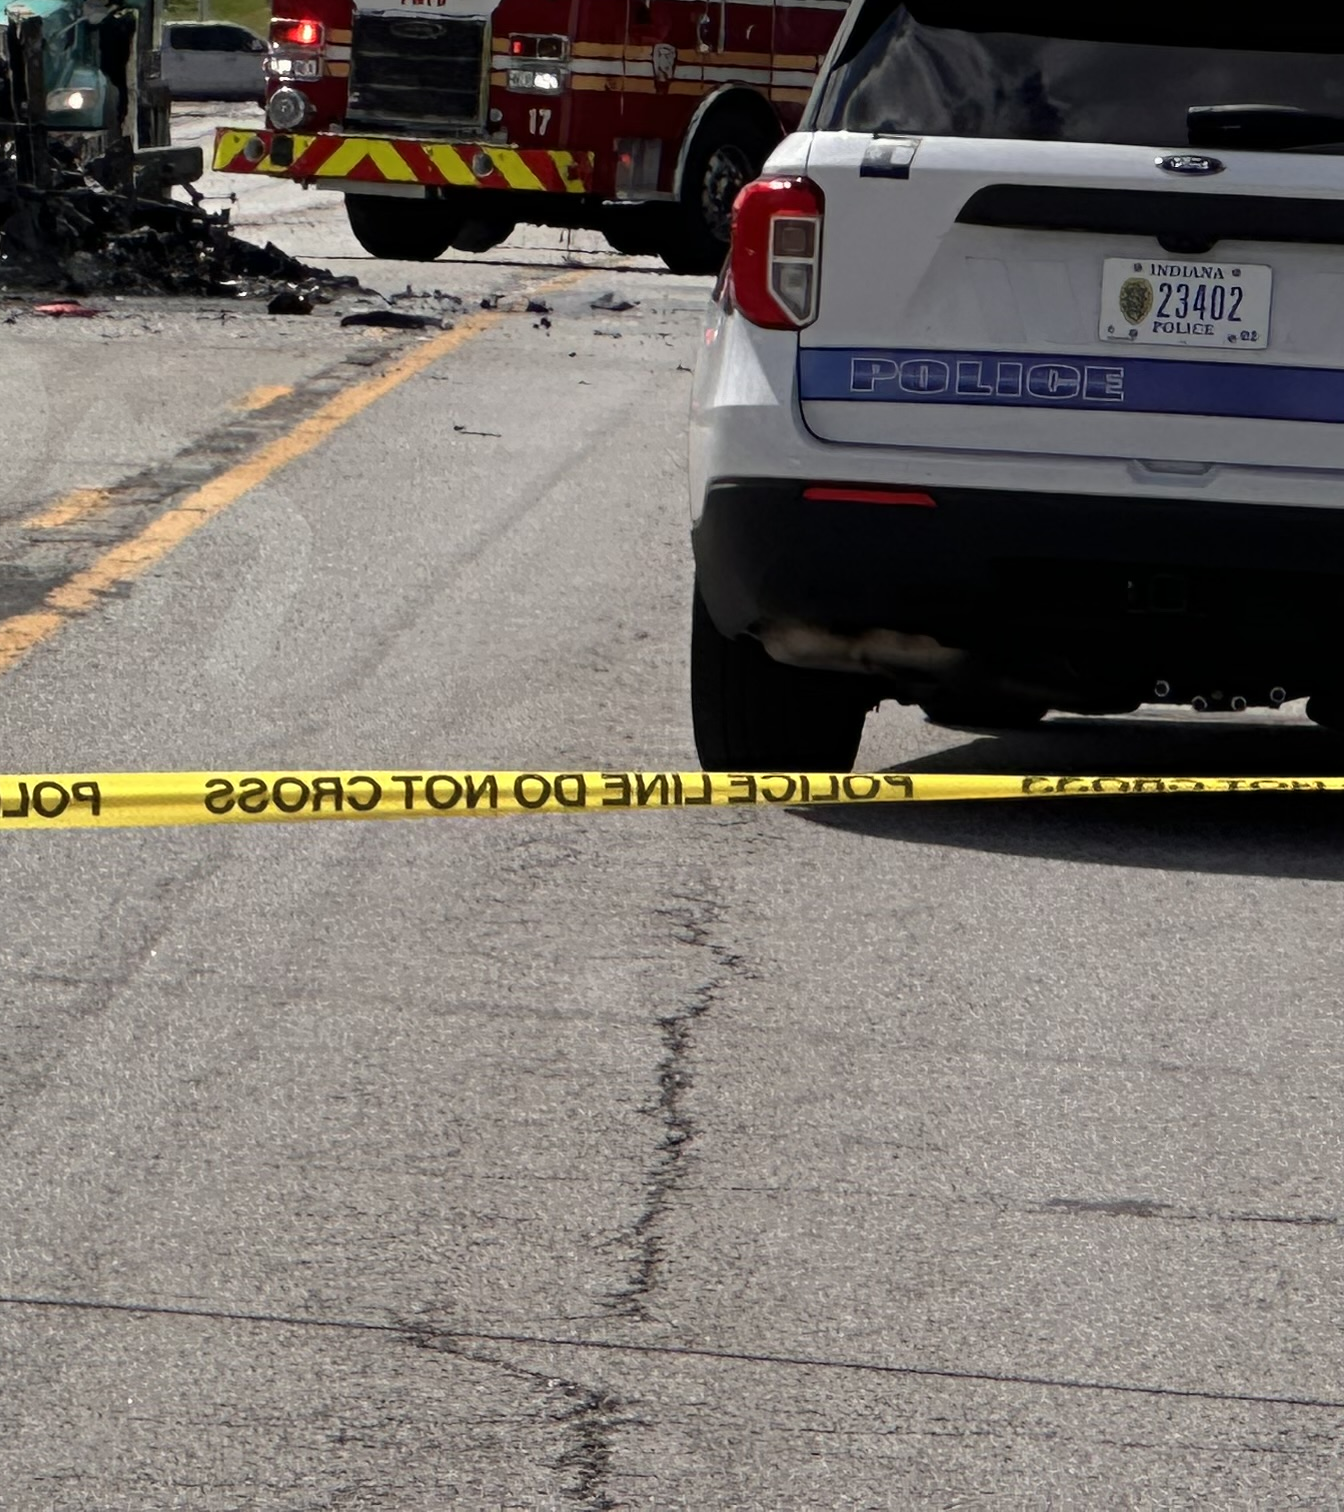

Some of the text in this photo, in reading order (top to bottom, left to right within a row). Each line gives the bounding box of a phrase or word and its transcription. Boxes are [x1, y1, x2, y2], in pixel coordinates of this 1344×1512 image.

[528, 107, 552, 136] 17
[1149, 263, 1225, 280] INDIANA
[1156, 282, 1244, 322] 23402
[1152, 321, 1215, 336] POLICE
[850, 357, 1124, 402] POLICE
